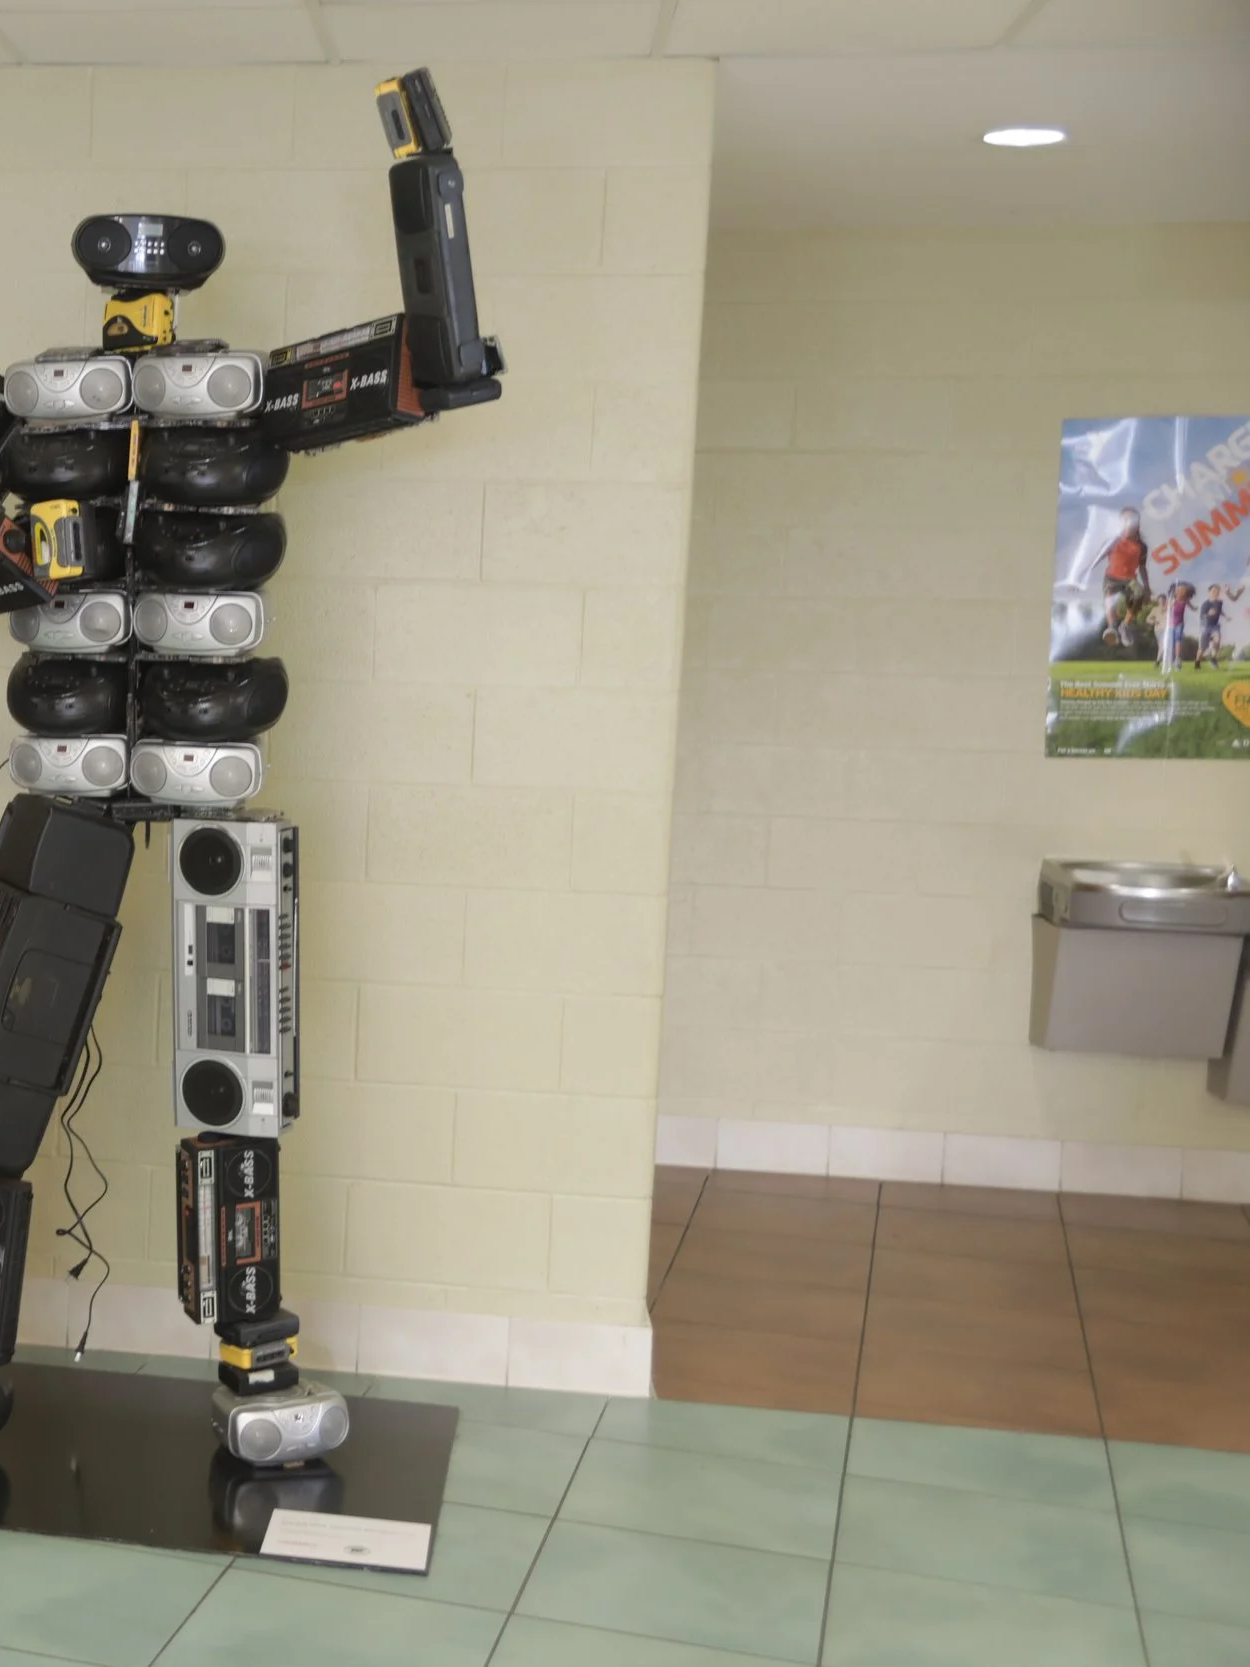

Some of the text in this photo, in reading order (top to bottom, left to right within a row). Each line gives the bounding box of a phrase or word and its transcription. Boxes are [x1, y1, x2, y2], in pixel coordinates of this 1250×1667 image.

[350, 369, 388, 391] X-BASS
[264, 393, 299, 413] X-BASS
[1062, 688, 1111, 698] HEALTHY
[1145, 688, 1167, 699] DAY
[244, 1150, 255, 1198] X-BASS
[246, 1266, 256, 1315] X-BASS
